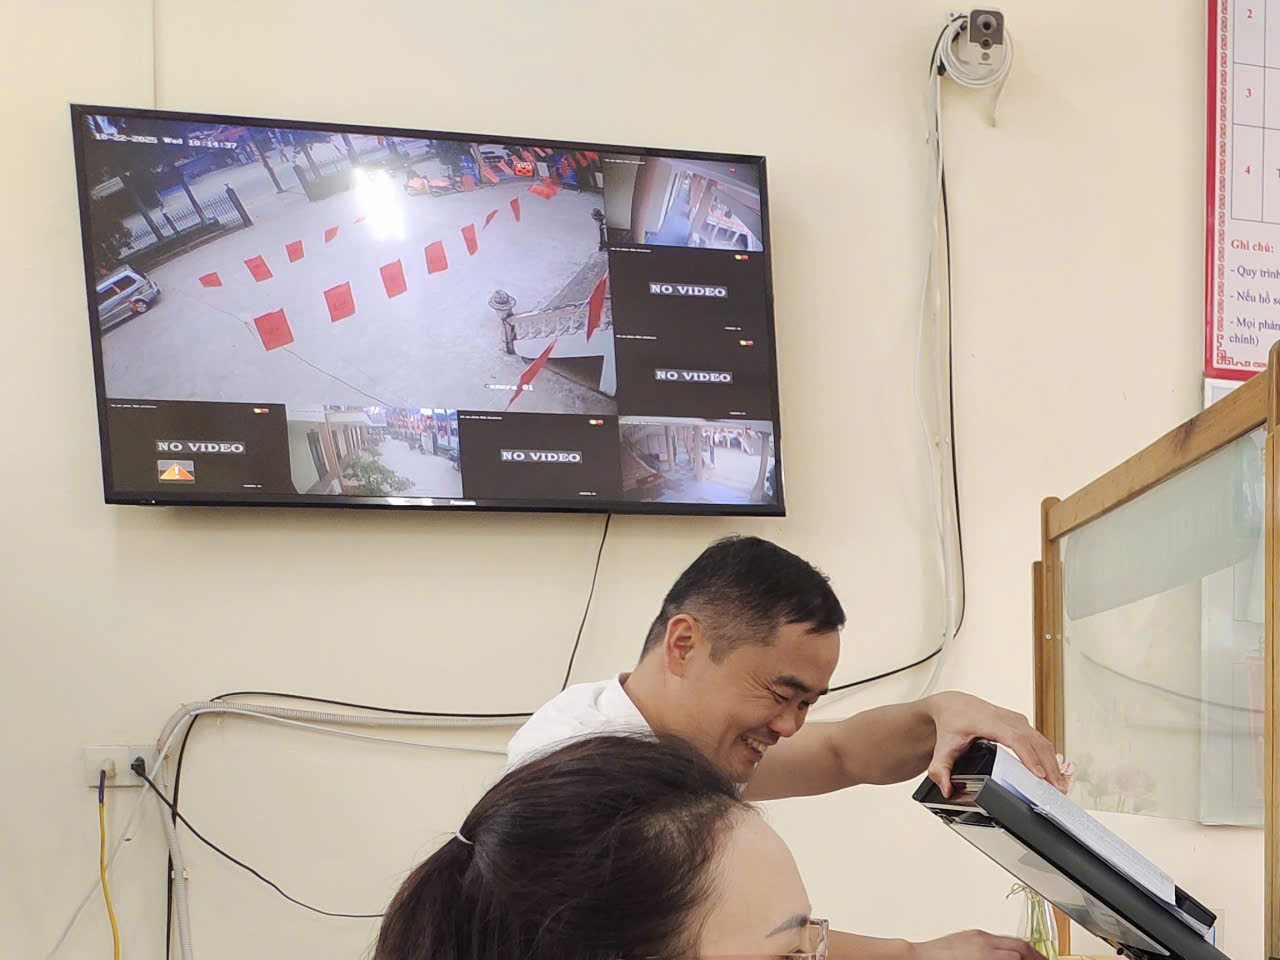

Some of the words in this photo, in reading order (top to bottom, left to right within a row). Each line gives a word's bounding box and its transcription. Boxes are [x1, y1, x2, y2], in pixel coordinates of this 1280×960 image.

[1247, 9, 1253, 18] 2
[1245, 88, 1252, 98] 3
[1244, 166, 1250, 175] 4
[1231, 239, 1249, 251] Ghi
[1252, 241, 1274, 253] chú:
[1237, 265, 1257, 279] Quy
[651, 284, 673, 294] NO
[677, 286, 726, 297] VIDEO
[1237, 289, 1256, 303] Nếu
[1259, 292, 1270, 304] hồ
[1236, 317, 1256, 329] Mọi
[1259, 320, 1280, 332] phản
[1229, 333, 1260, 345] chính)
[656, 371, 678, 380] NO
[682, 372, 731, 382] VIDEO
[157, 442, 182, 451] NO
[188, 443, 244, 452] VIDEO
[502, 452, 525, 461] NO
[529, 452, 580, 462] VIDEO
